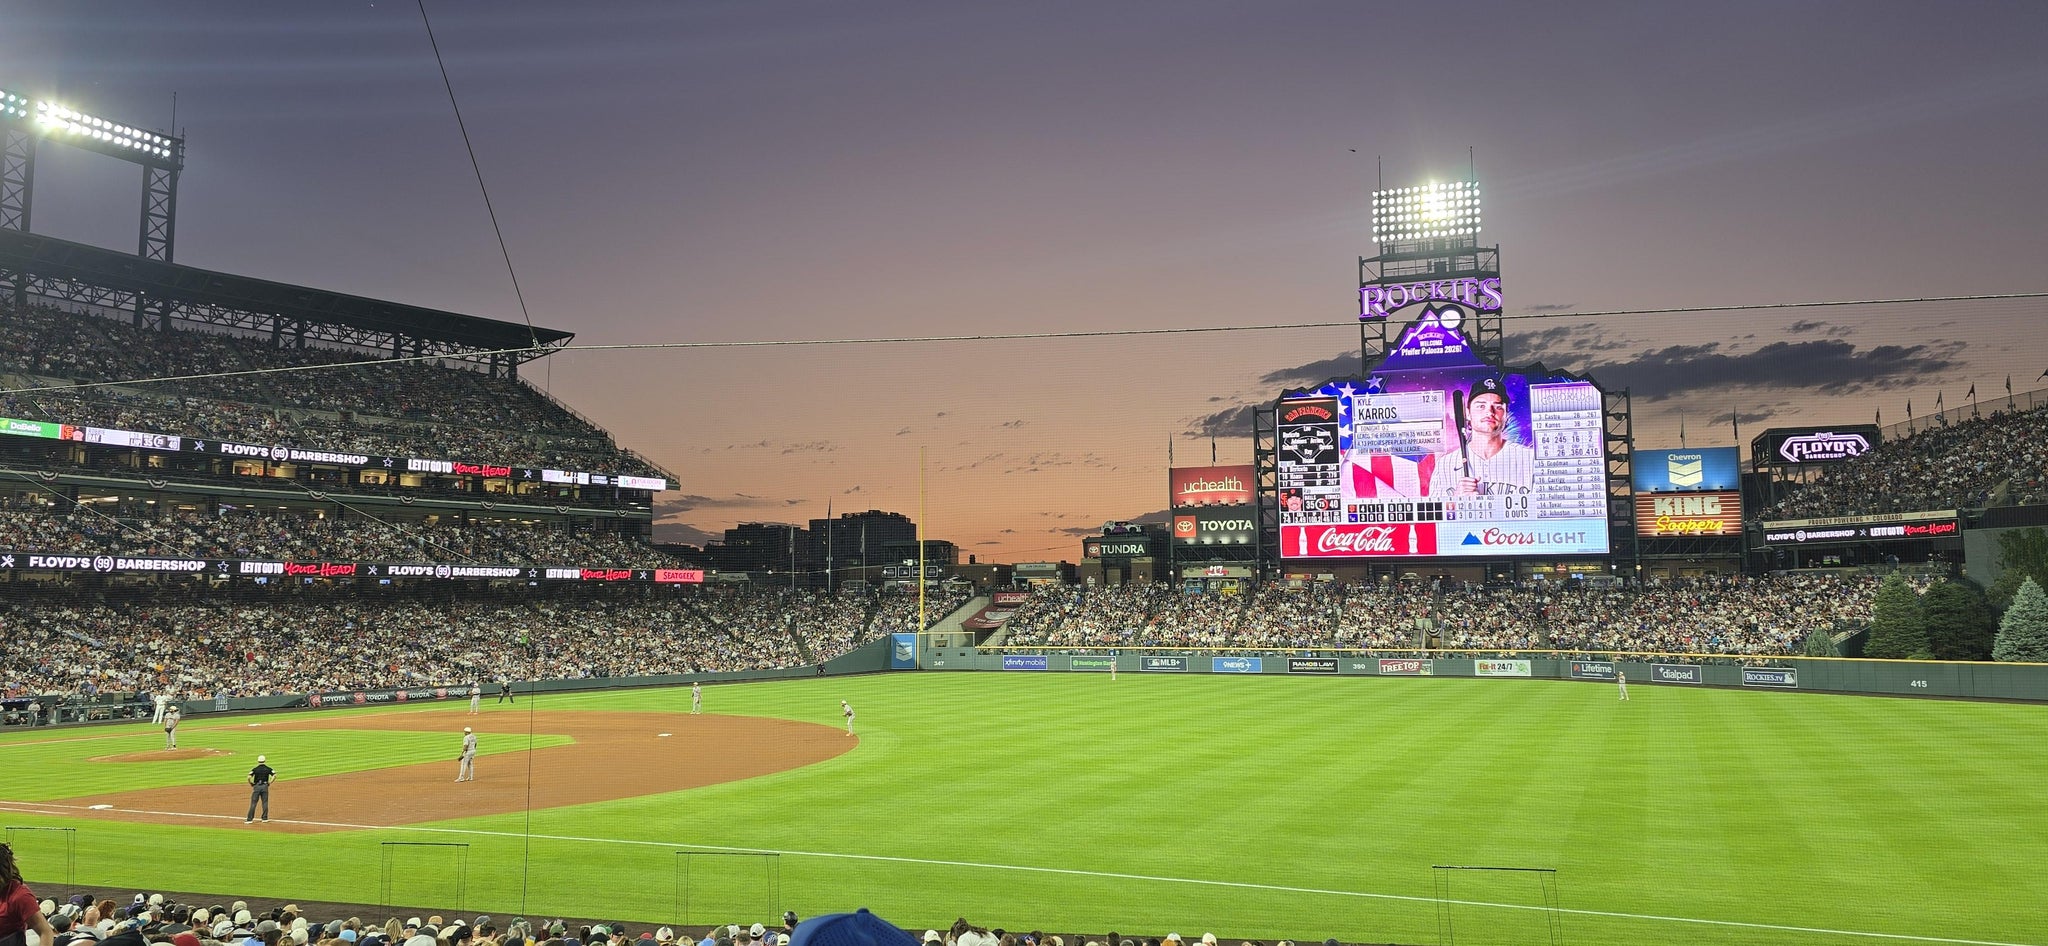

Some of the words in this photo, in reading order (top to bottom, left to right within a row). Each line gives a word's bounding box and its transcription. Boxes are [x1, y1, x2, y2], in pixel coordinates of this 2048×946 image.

[1359, 278, 1502, 318] ROCKIES
[1358, 407, 1397, 420] KARROS
[221, 444, 268, 456] FLOYD'S
[291, 450, 368, 464] BARBERSHOP
[1793, 441, 1857, 458] FLOYD'S
[408, 459, 422, 470] LET
[422, 460, 430, 471] IT
[430, 460, 441, 472] GO
[442, 461, 452, 473] TO
[1184, 476, 1242, 492] uchealth
[1329, 500, 1338, 508] 40
[1654, 496, 1722, 516] KING
[1200, 520, 1254, 530] TOYOTA
[1656, 516, 1724, 534] Soopers
[1318, 527, 1396, 552] Coca-Cola
[1483, 527, 1535, 545] Coors
[1538, 532, 1586, 544] LIGHT
[1767, 533, 1795, 541] FLOYD'S
[1807, 530, 1855, 539] BARBERSHOP
[1870, 528, 1880, 536] LET
[1880, 527, 1887, 536] IT
[1101, 544, 1144, 554] TUNDRA
[29, 556, 90, 568] FLOYD'S
[117, 560, 206, 571] BARBERSHOP
[240, 562, 253, 573] LET
[254, 562, 262, 573] IT
[262, 563, 273, 573] GO
[273, 563, 283, 574] TO
[388, 566, 433, 576] FLOYD'S
[452, 567, 520, 577] BARBERSHOP
[546, 569, 558, 578] LET
[558, 569, 563, 578] IT
[563, 569, 571, 578] GO
[572, 570, 580, 579] TO
[663, 571, 695, 580] SEATGEEK
[1582, 664, 1612, 673] Lifetime
[1663, 670, 1693, 680] dialpad
